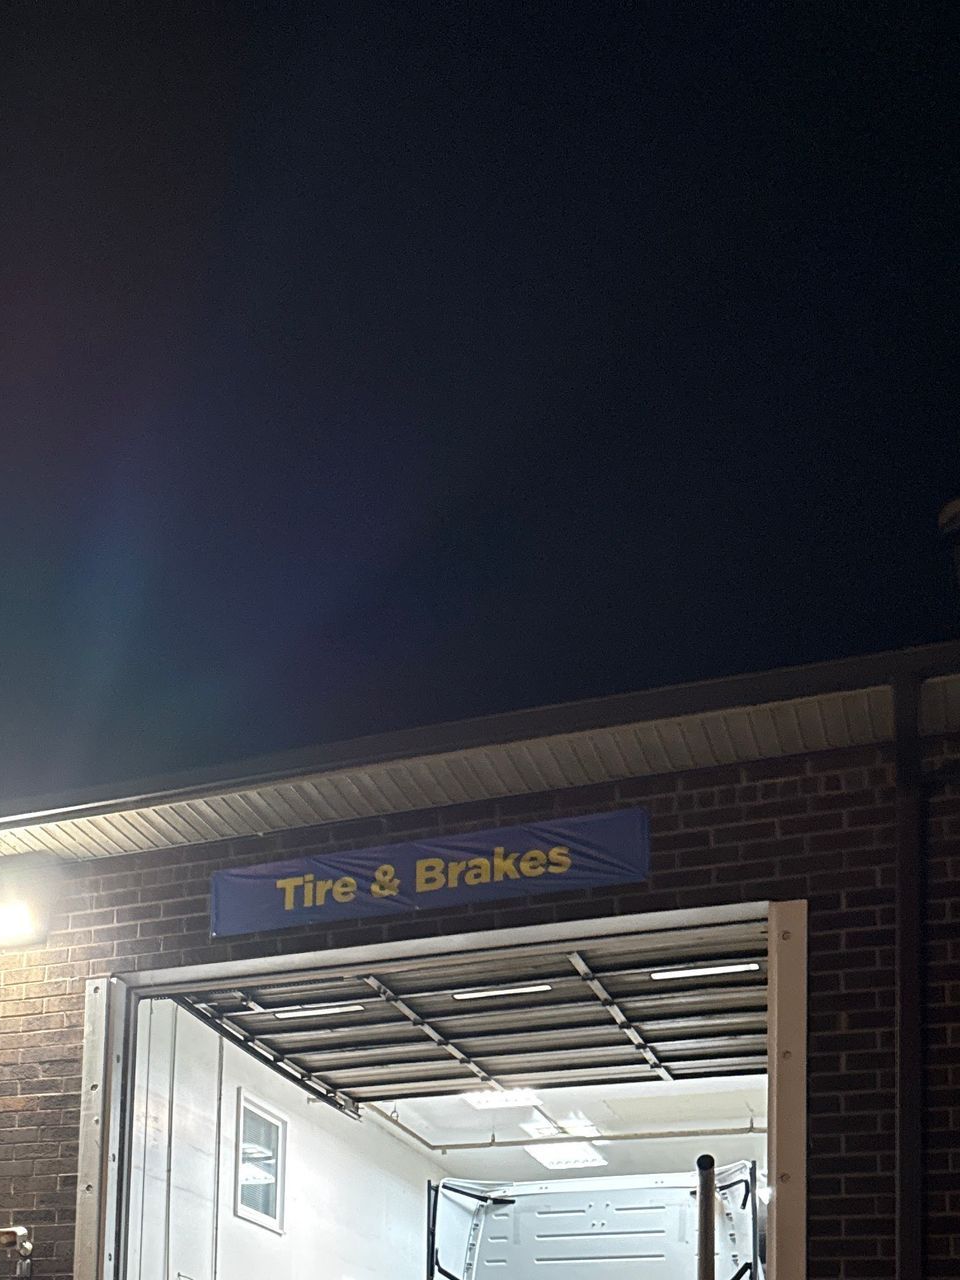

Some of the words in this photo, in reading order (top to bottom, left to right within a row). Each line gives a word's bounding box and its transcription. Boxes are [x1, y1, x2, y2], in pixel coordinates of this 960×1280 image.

[276, 873, 357, 911] Tire
[371, 863, 401, 898] &
[415, 845, 572, 894] Brakes
